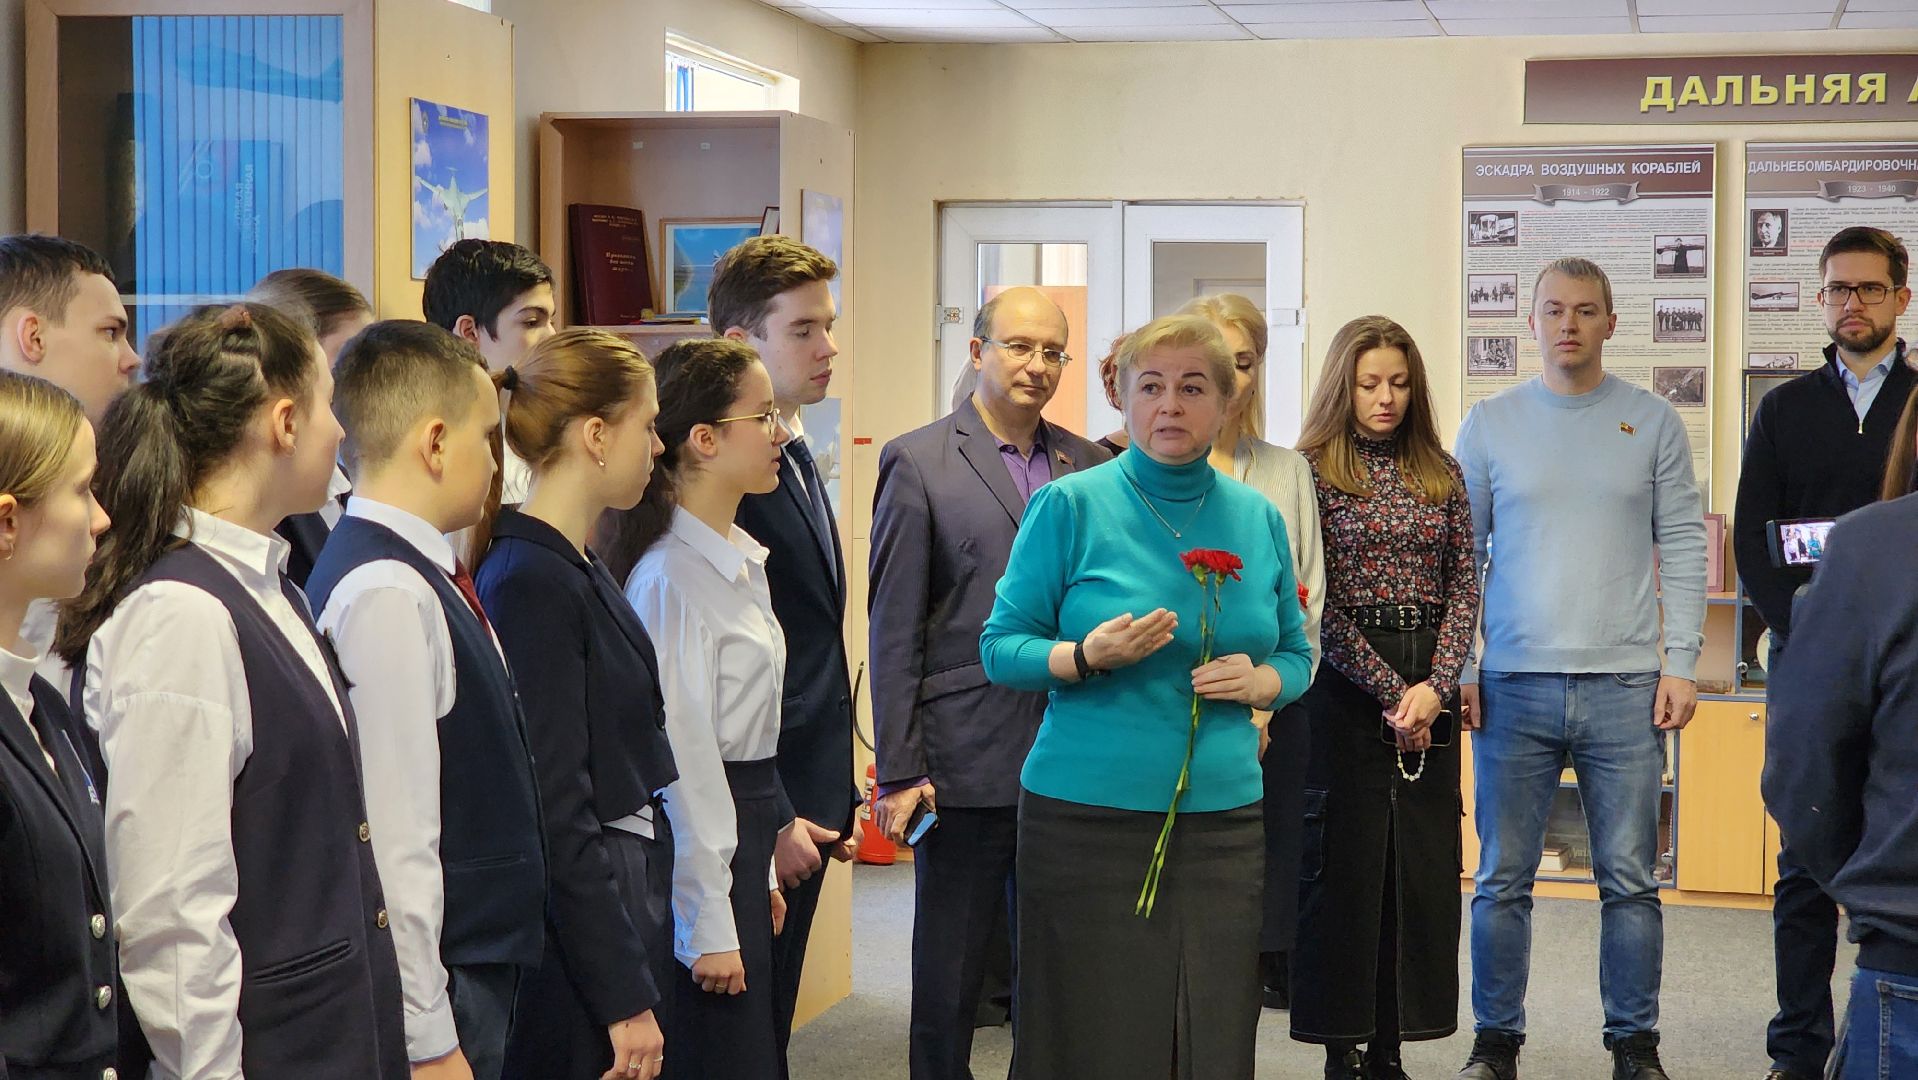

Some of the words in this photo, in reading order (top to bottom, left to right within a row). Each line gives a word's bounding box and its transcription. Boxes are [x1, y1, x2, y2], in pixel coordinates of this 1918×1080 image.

[1640, 73, 1887, 112] ДАЛЬНЯЯ
[1475, 164, 1535, 177] ЭСКАДРА
[1541, 162, 1626, 177] ВОЗДУШНЫХ
[1632, 160, 1701, 175] КОРАБЛЕЙ
[1748, 159, 1918, 174] ДАЛЬНЕБОМБАРДИРОВОЧН
[1562, 188, 1581, 197] 1914
[1591, 187, 1610, 196] 1922
[1847, 184, 1867, 193] 1923
[1878, 184, 1896, 193] 1940
